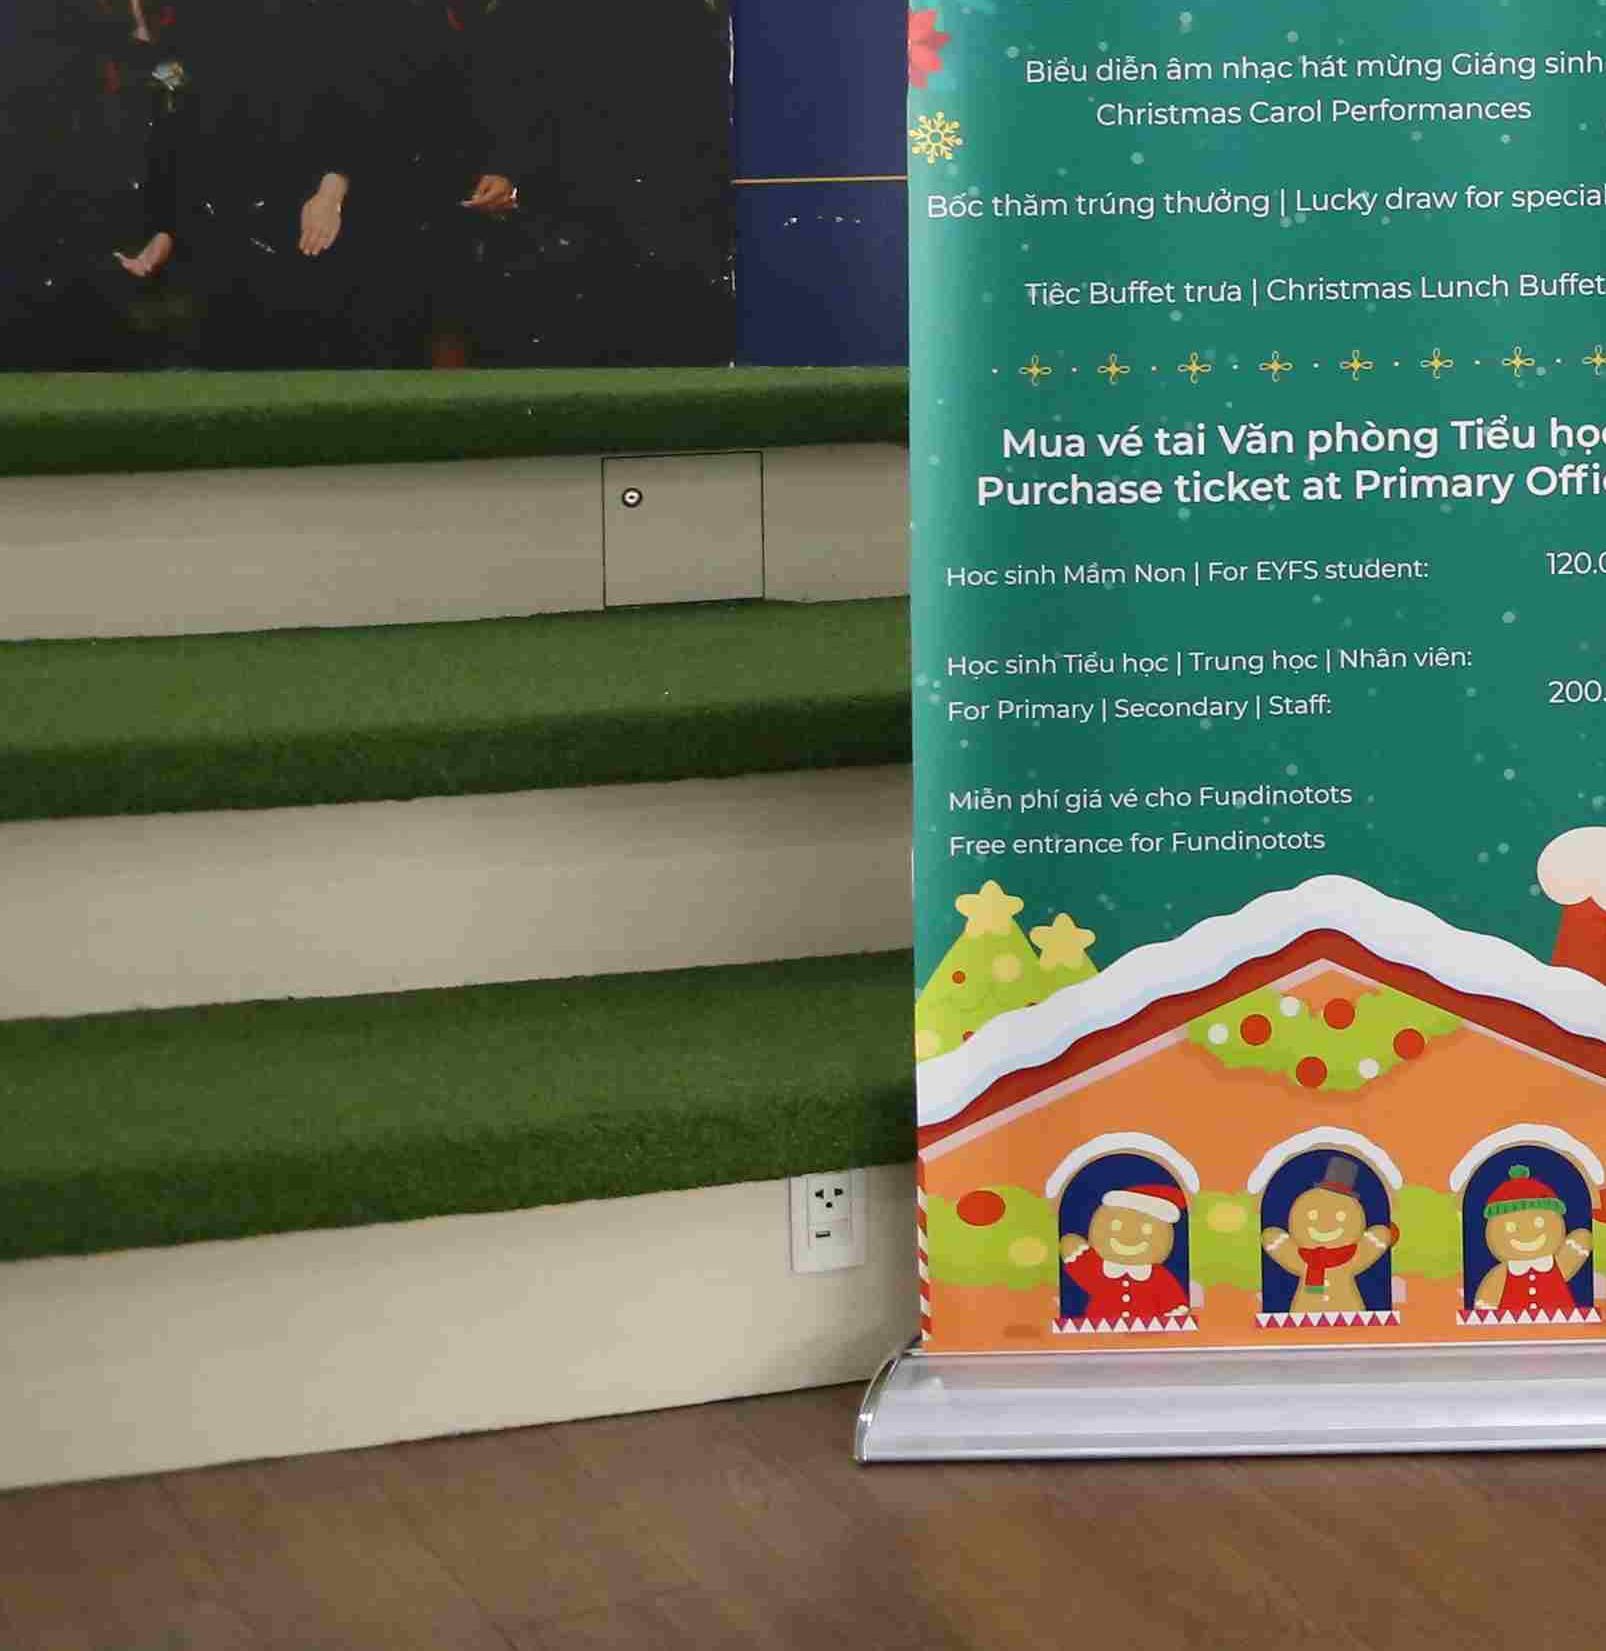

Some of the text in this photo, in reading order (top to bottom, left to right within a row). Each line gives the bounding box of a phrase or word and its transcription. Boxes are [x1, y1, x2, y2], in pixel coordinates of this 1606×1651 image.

[1026, 56, 1088, 83] Biểu
[1166, 57, 1212, 81] âm
[1222, 55, 1293, 84] nhạc
[1301, 54, 1348, 79] hát
[1356, 53, 1442, 82] mừng
[1451, 51, 1536, 80] Giáng
[1544, 50, 1603, 74] sinh
[1096, 97, 1532, 126] Christmas Carol Performances
[927, 192, 984, 218] Bốc
[991, 193, 1068, 217] thăm
[1074, 191, 1155, 220] trúng
[1162, 188, 1270, 218] thưởng
[1296, 187, 1378, 216] Lucky
[1385, 186, 1458, 210] draw
[1464, 184, 1505, 209] for
[1089, 279, 1176, 305] Buffet
[1183, 280, 1242, 303] trưa
[1266, 277, 1413, 302] Christmas
[1421, 273, 1509, 299] Lunch
[1519, 272, 1606, 297] Buffet
[1003, 428, 1086, 458] Mua
[1096, 424, 1144, 457] vé
[1216, 422, 1294, 455] Văn
[1308, 420, 1439, 462] phòng
[1449, 414, 1536, 450] Tiểu
[977, 473, 1163, 506] Purchase
[1173, 470, 1291, 503] ticket
[1302, 471, 1343, 501] at
[1355, 466, 1515, 505] Primary
[1004, 564, 1056, 586] sinh
[1134, 563, 1186, 583] Non
[1208, 561, 1249, 582] For
[1256, 559, 1319, 581] EYFS
[1324, 557, 1429, 580] student:
[947, 656, 999, 680] Học
[1005, 653, 1057, 675] sinh
[1063, 651, 1115, 674] Tiểu
[1122, 652, 1169, 678] học
[1188, 652, 1264, 676] Trung
[1272, 649, 1318, 674] học
[1339, 647, 1407, 669] Nhân
[1413, 646, 1472, 667] viên:
[948, 701, 990, 721] For
[998, 699, 1094, 724] Primary
[1114, 696, 1249, 720] Secondary
[1269, 693, 1332, 716] Staff:
[1020, 788, 1060, 814] phí
[1065, 788, 1103, 814] giá
[1109, 788, 1139, 809] vé
[1144, 786, 1192, 808] cho
[1199, 784, 1353, 807] Fundinotots
[950, 829, 1326, 857] Free entrance for Fundinotots
